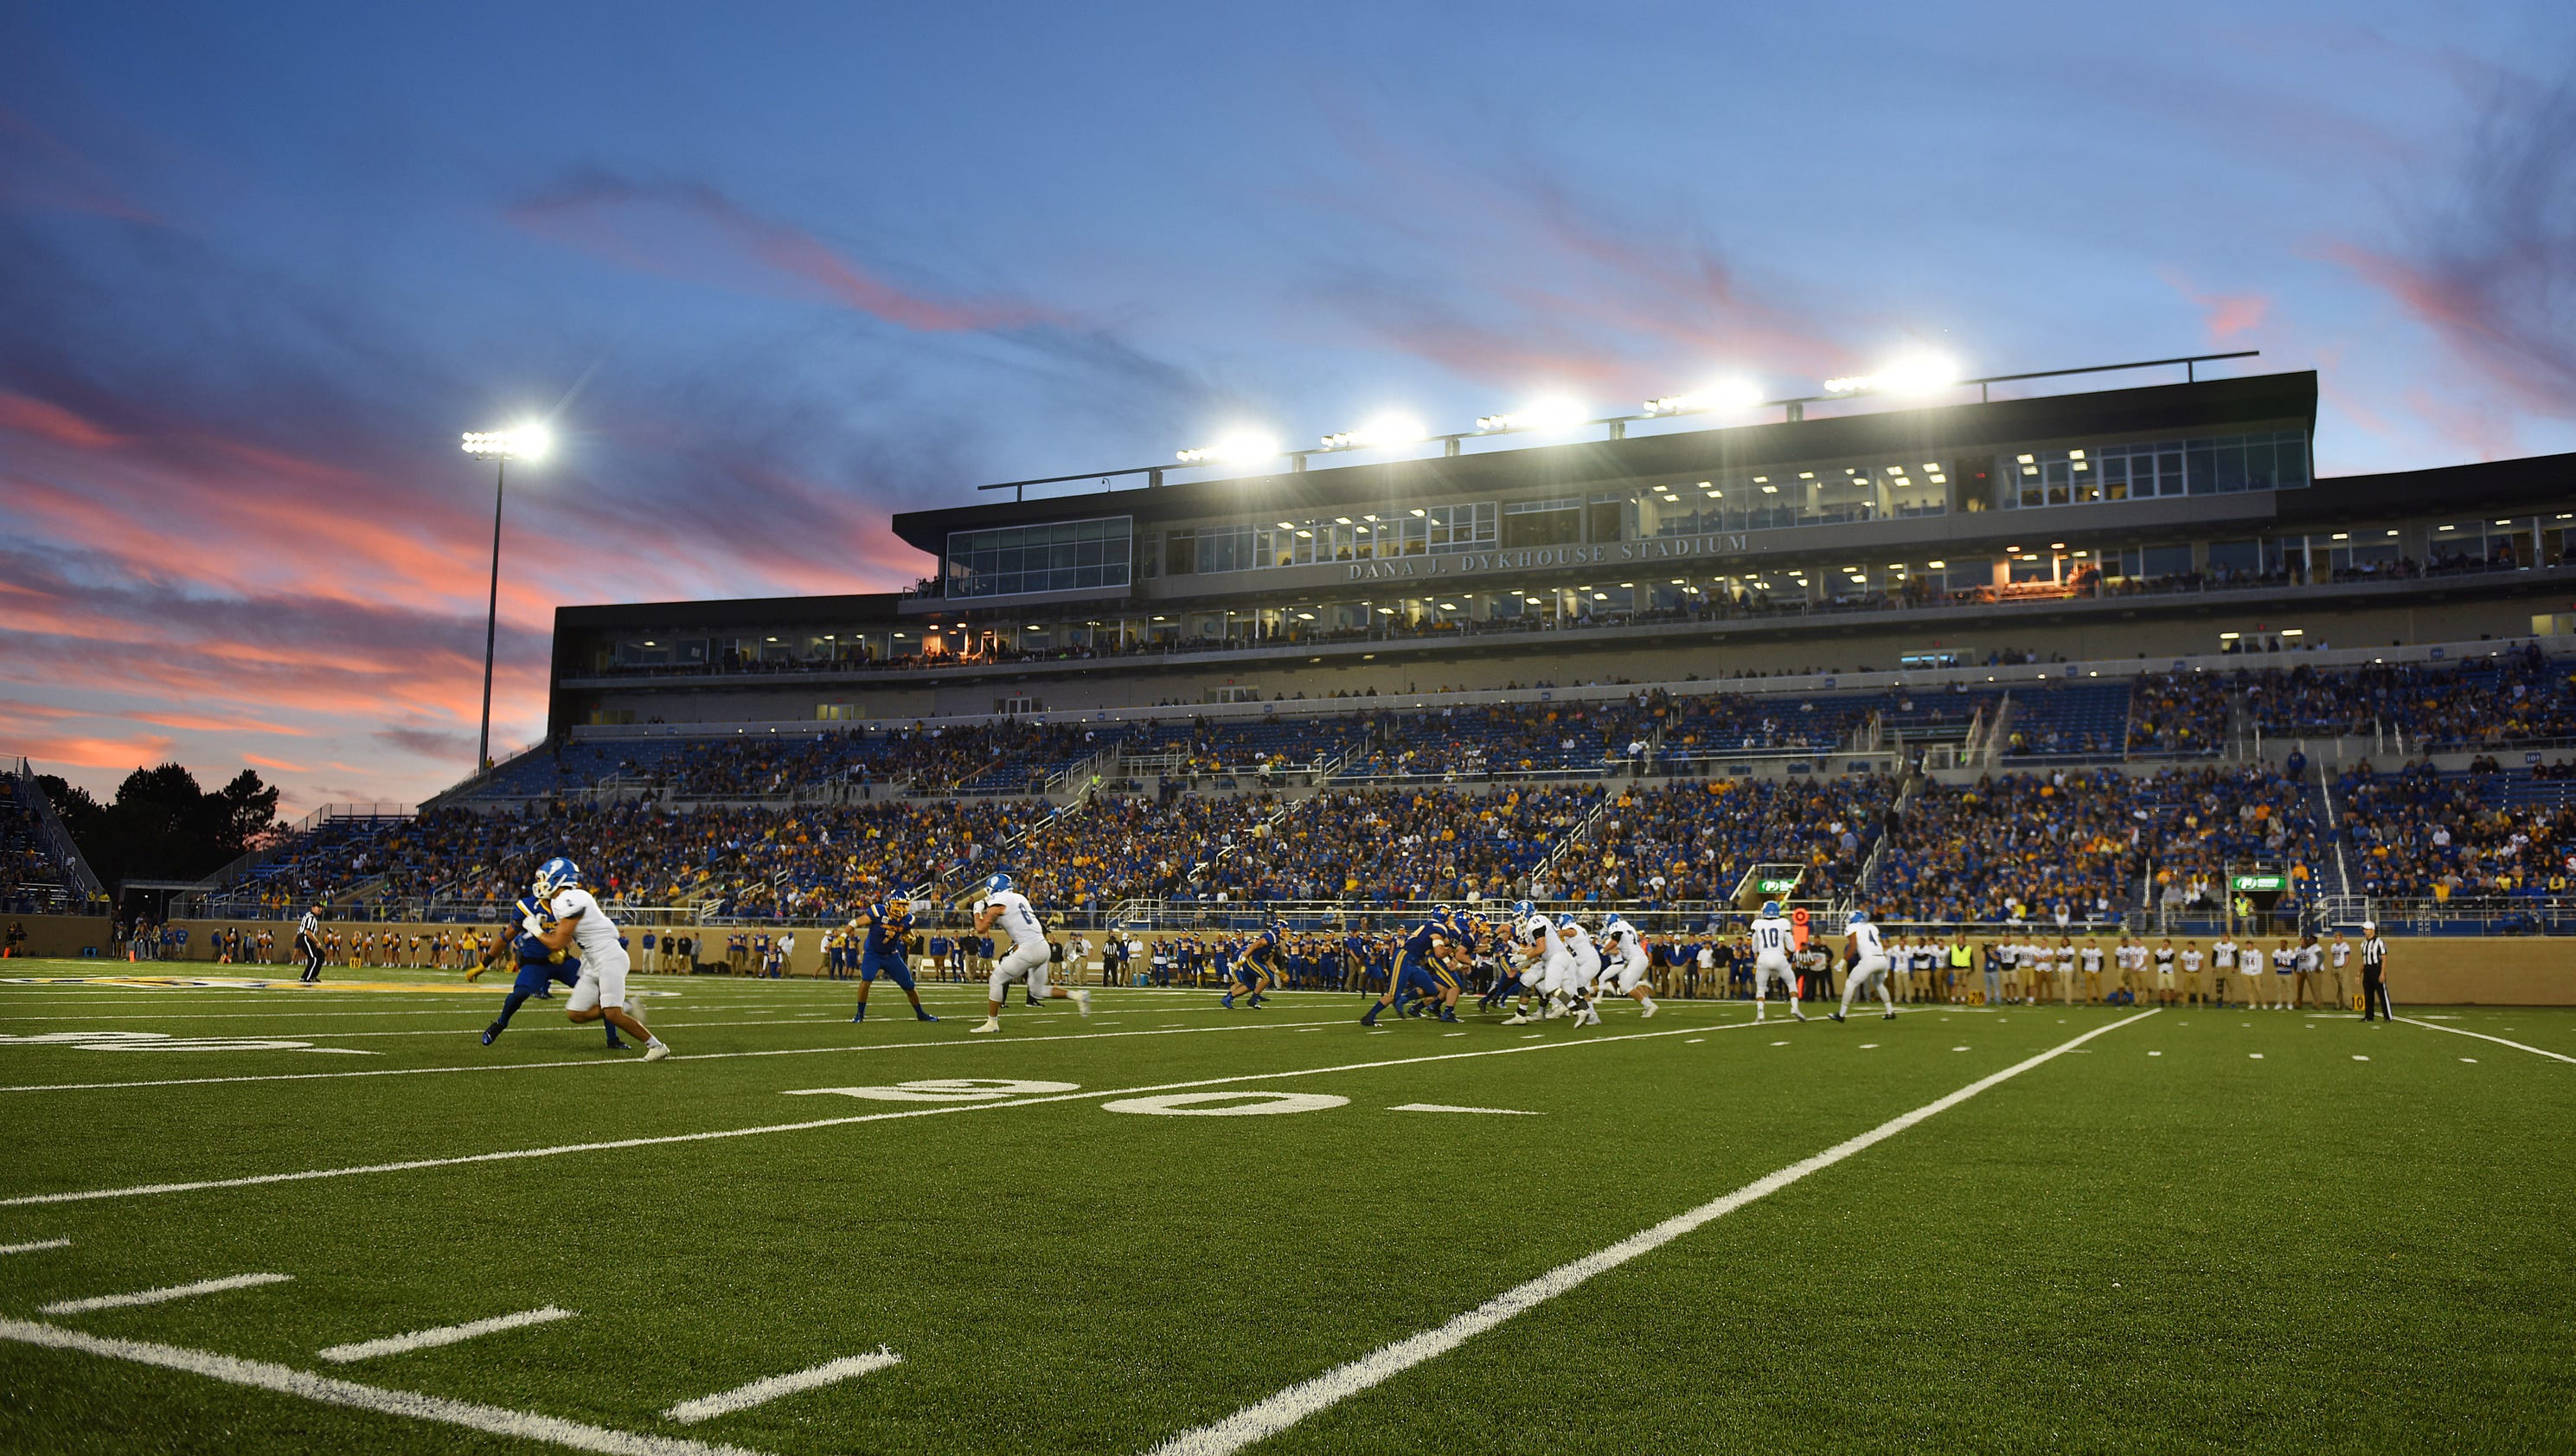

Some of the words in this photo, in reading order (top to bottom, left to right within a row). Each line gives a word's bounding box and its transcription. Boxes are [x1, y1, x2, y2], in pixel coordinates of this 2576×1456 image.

[1349, 561, 1414, 580] DANA
[1428, 558, 1447, 574] J.
[1461, 546, 1605, 572] DYKHOUSE
[1621, 535, 1747, 560] STADIUM
[1761, 927, 1778, 948] 10
[1868, 929, 1878, 946] 4
[2351, 996, 2364, 1010] 10
